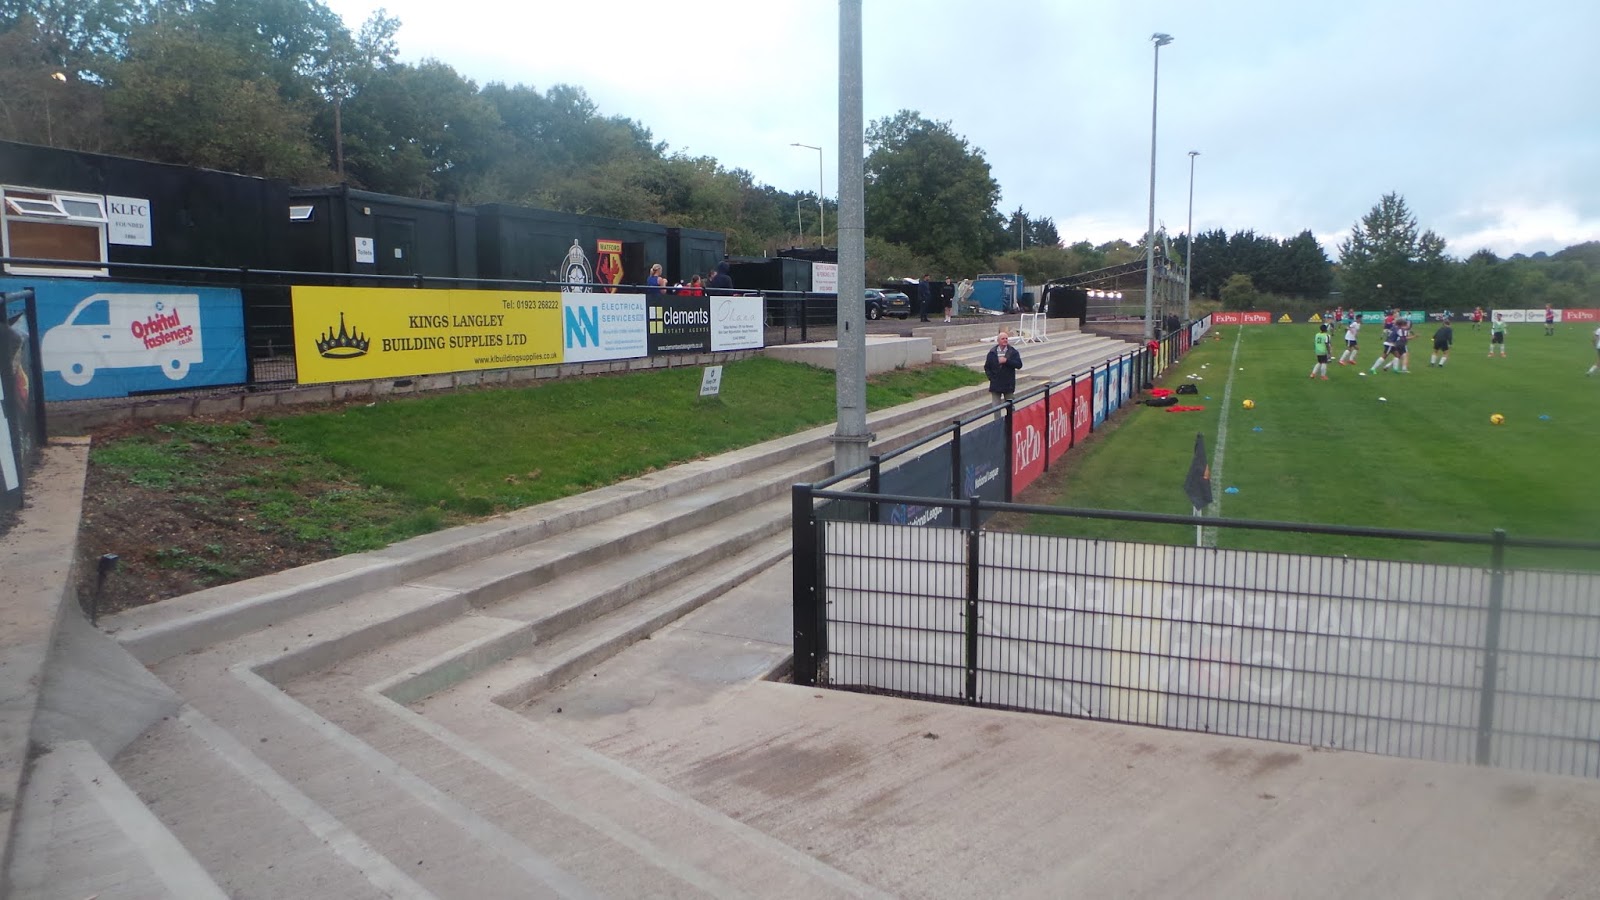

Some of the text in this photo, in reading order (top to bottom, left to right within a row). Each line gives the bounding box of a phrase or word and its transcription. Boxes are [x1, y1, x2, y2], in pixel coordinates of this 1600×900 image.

[111, 203, 147, 217] KLFC
[600, 243, 620, 252] WATFORD
[502, 300, 559, 310] Tel: 01923 268222
[601, 303, 644, 311] ELECTRICAL
[409, 314, 505, 329] KINGS LANGLEY
[602, 314, 635, 323] SERVICES
[663, 306, 709, 325] clements
[1216, 314, 1237, 322] FxPro
[1244, 314, 1267, 322] FxPro
[1567, 312, 1594, 320] FxPro
[131, 308, 181, 339] Orbital
[143, 325, 194, 350] fasteners
[382, 333, 527, 352] BUILDING SUPPLIES LTD
[474, 352, 557, 365] www.klbuildingsupplies.co.uk
[1048, 406, 1068, 449] FxPro
[1015, 424, 1041, 475] FxPro
[974, 471, 988, 490] National
[987, 467, 999, 481] League
